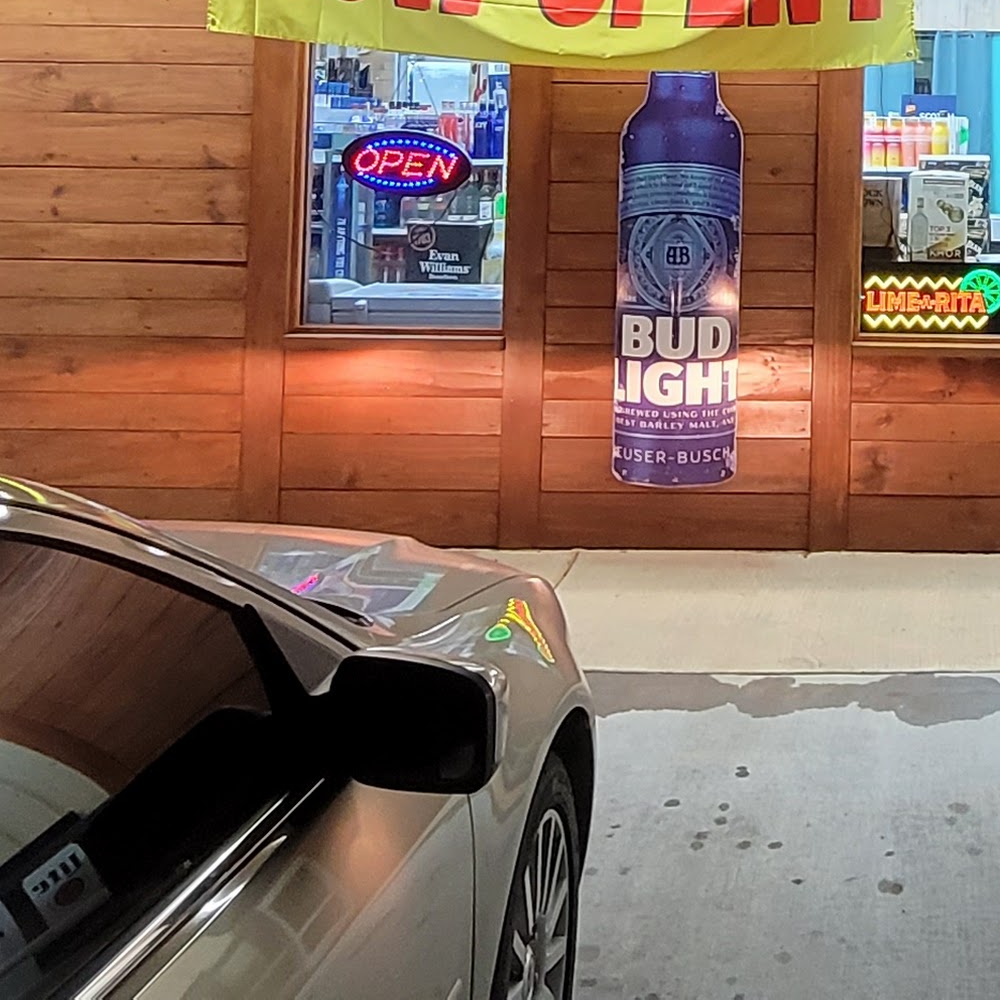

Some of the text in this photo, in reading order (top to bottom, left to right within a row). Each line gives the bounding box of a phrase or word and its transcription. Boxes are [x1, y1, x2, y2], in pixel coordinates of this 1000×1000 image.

[354, 146, 458, 181] OPEN
[428, 249, 459, 261] Evan
[418, 261, 472, 274] Williams
[621, 314, 731, 361] BUD
[663, 410, 698, 419] USING
[702, 409, 719, 418] THE
[639, 420, 684, 430] BARLEY
